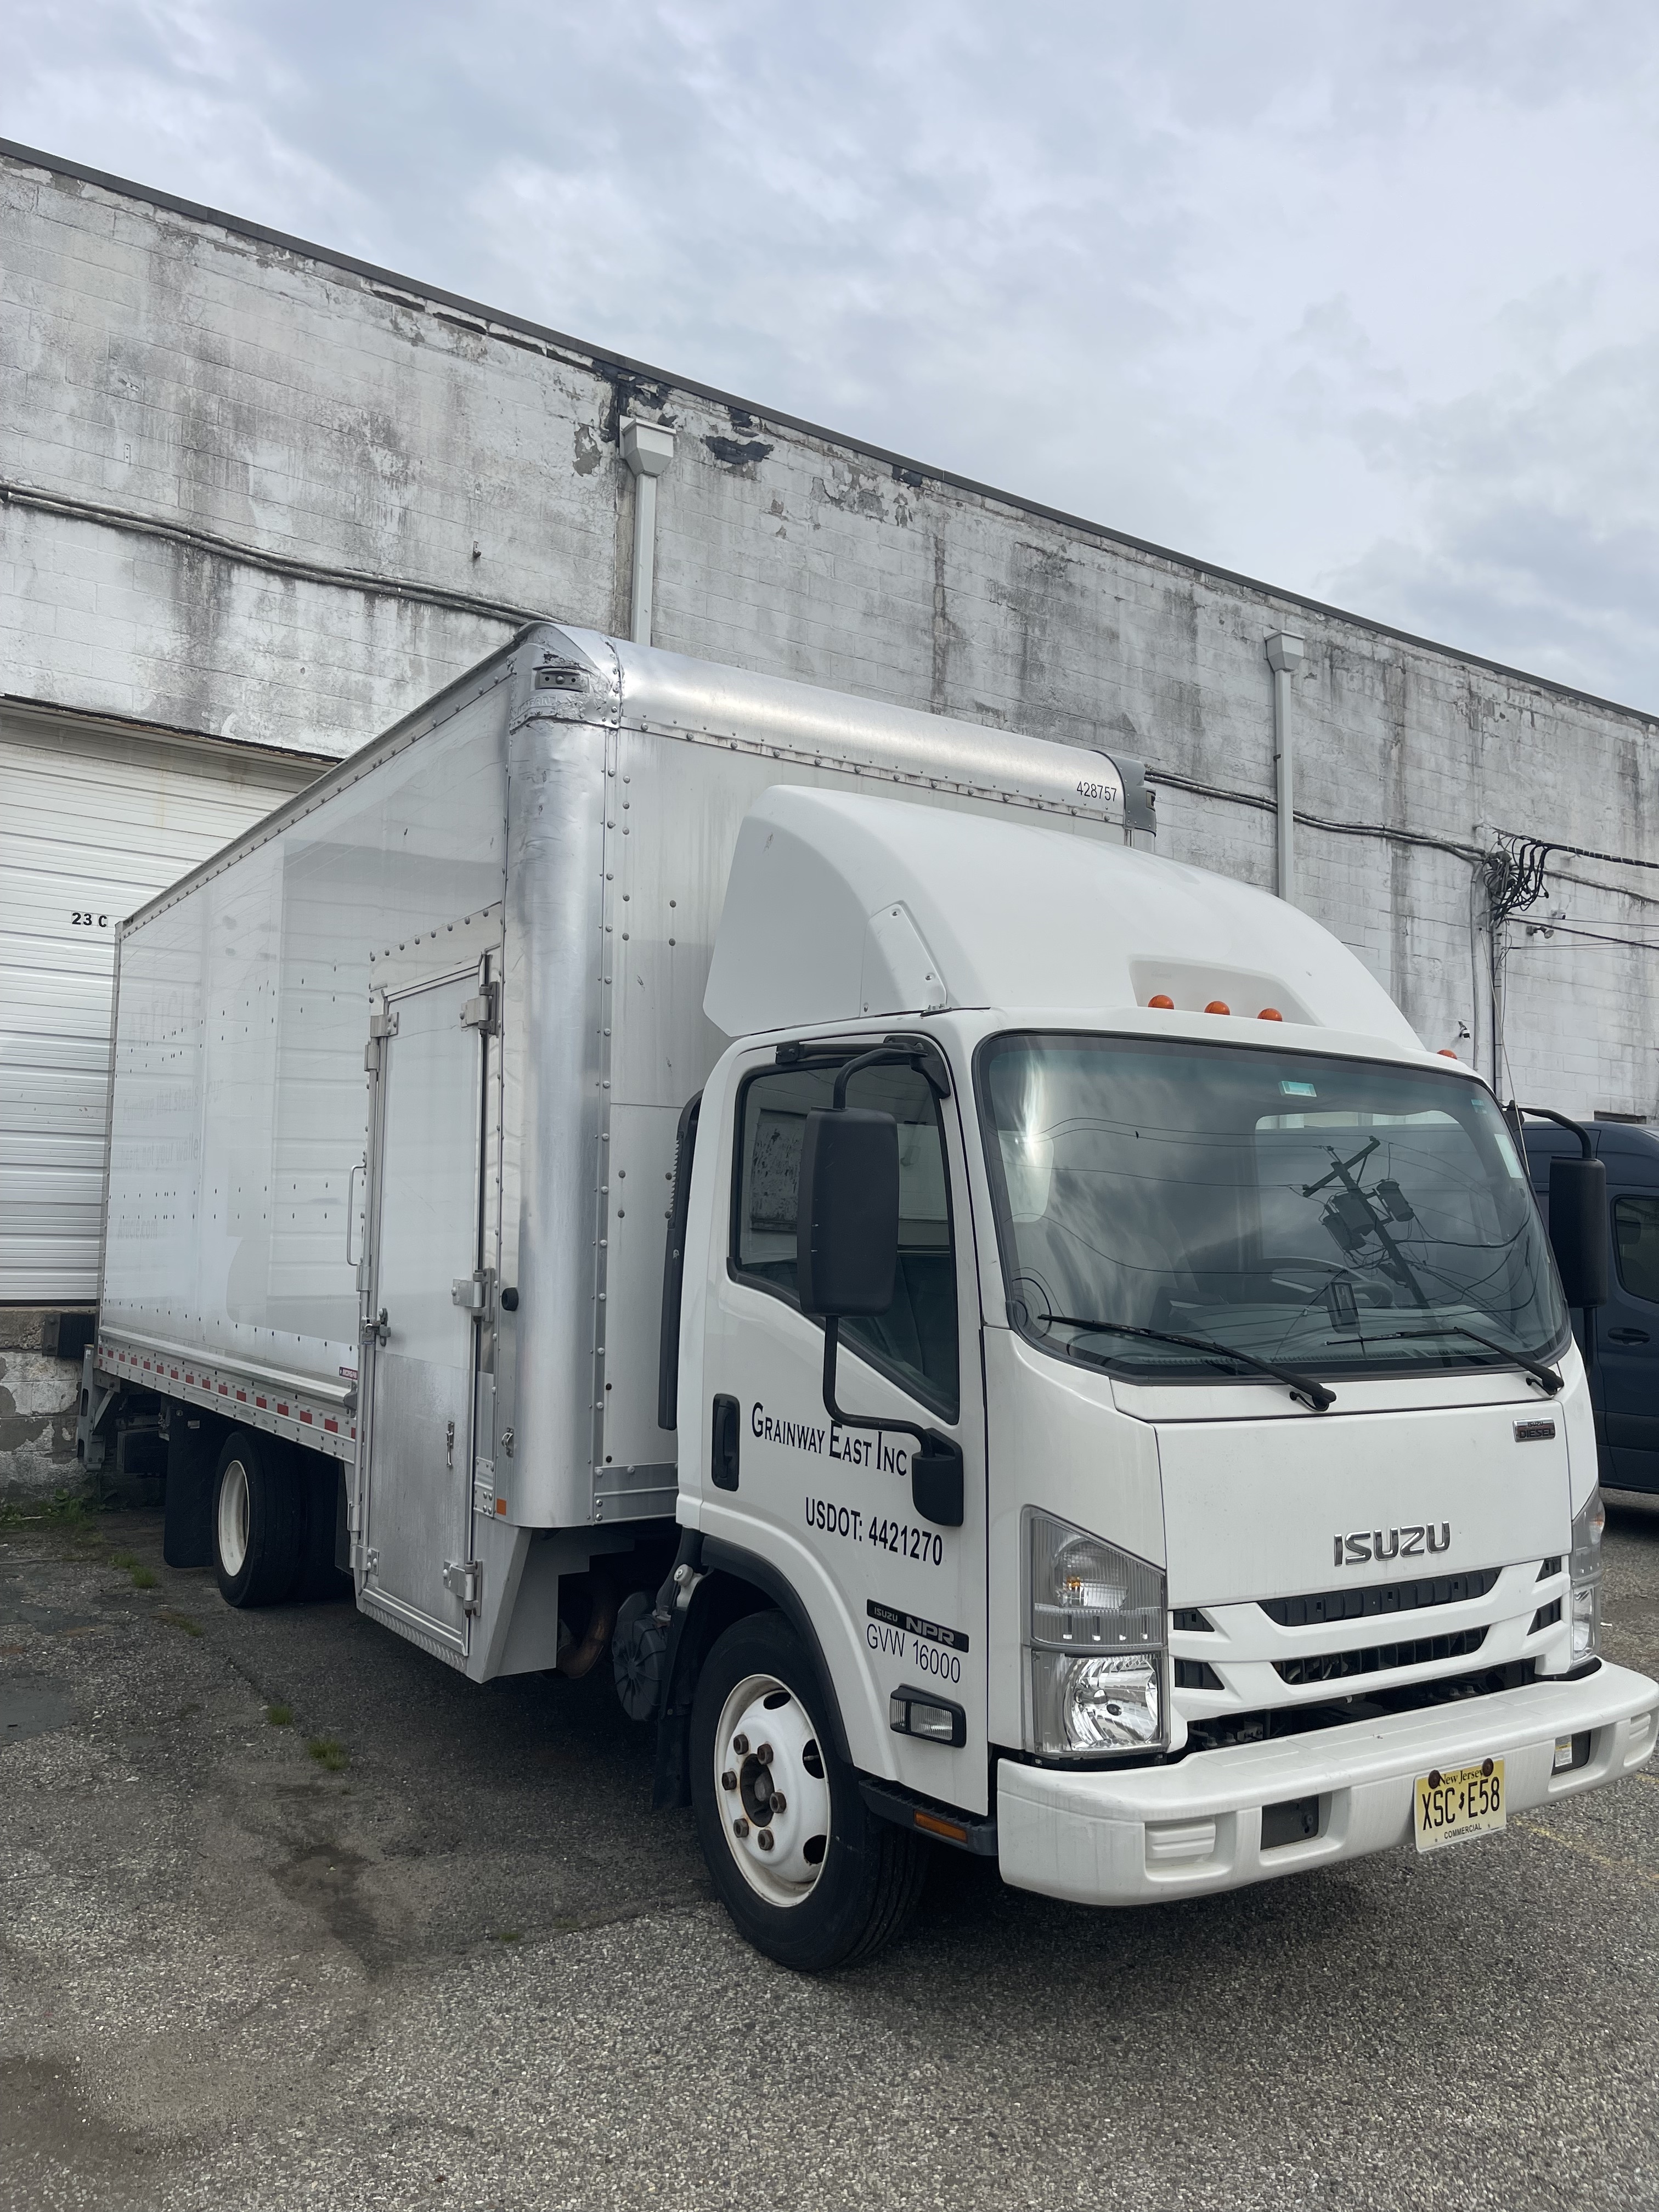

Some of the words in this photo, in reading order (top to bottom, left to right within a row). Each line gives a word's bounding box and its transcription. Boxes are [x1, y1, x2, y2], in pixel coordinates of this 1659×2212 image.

[1076, 781, 1117, 802] 428757
[72, 912, 92, 926] 23
[98, 915, 107, 928] C
[752, 1402, 826, 1454] GRAINWAY
[828, 1420, 872, 1466] EAST
[877, 1431, 907, 1476] INC
[1519, 1428, 1555, 1438] DIESEL
[806, 1497, 862, 1542] USDOT:
[868, 1516, 943, 1566] 4421270
[1334, 1521, 1450, 1567] ISUZU
[874, 1606, 898, 1623] ISUZU
[906, 1616, 955, 1646] NPR
[867, 1623, 905, 1657] GVW
[913, 1639, 961, 1683] 16000
[1437, 1774, 1458, 1787] New
[1421, 1787, 1455, 1831] XSC
[1468, 1776, 1500, 1819] E58
[1444, 1823, 1482, 1839] COMMERCIAL
